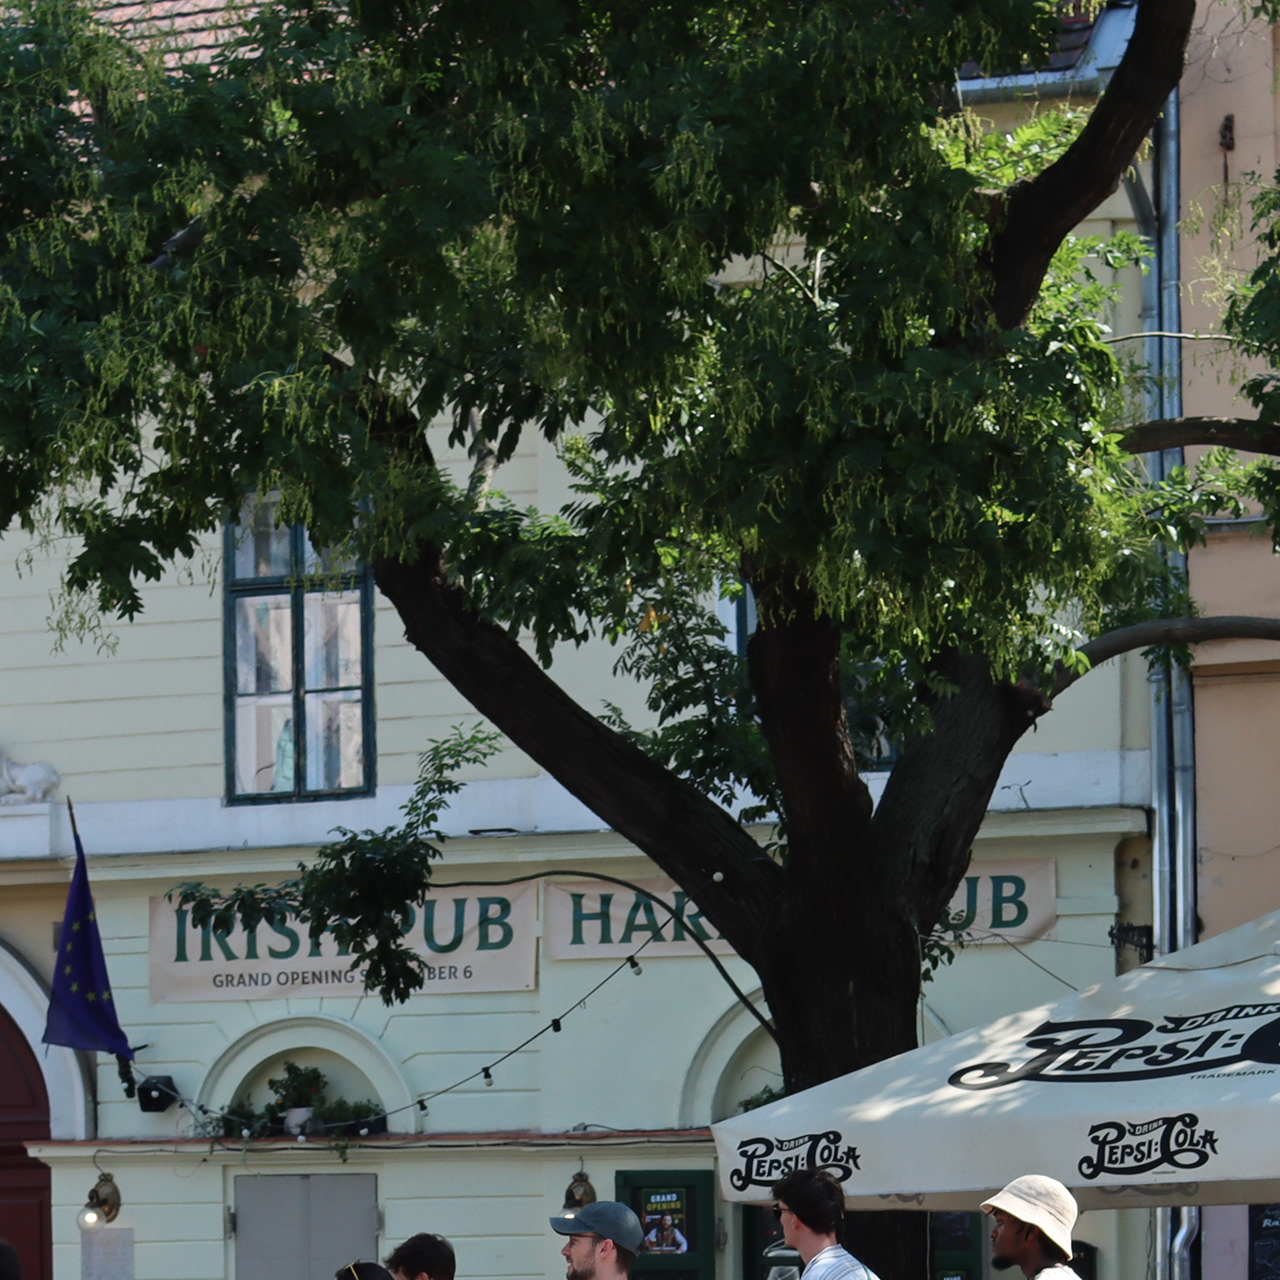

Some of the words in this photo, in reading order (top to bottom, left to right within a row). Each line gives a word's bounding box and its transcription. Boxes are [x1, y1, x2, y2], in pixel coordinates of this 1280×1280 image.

[570, 891, 725, 945] HAR
[942, 875, 1029, 931] UB
[213, 973, 271, 988] GRAND
[276, 969, 355, 986] OPENING
[463, 965, 473, 979] 6
[1189, 1069, 1277, 1080] TRADEMARK
[1135, 1119, 1164, 1135] DRINK
[782, 1136, 809, 1150] DRINK
[650, 1193, 677, 1203] GRAND
[646, 1201, 681, 1211] OPENING
